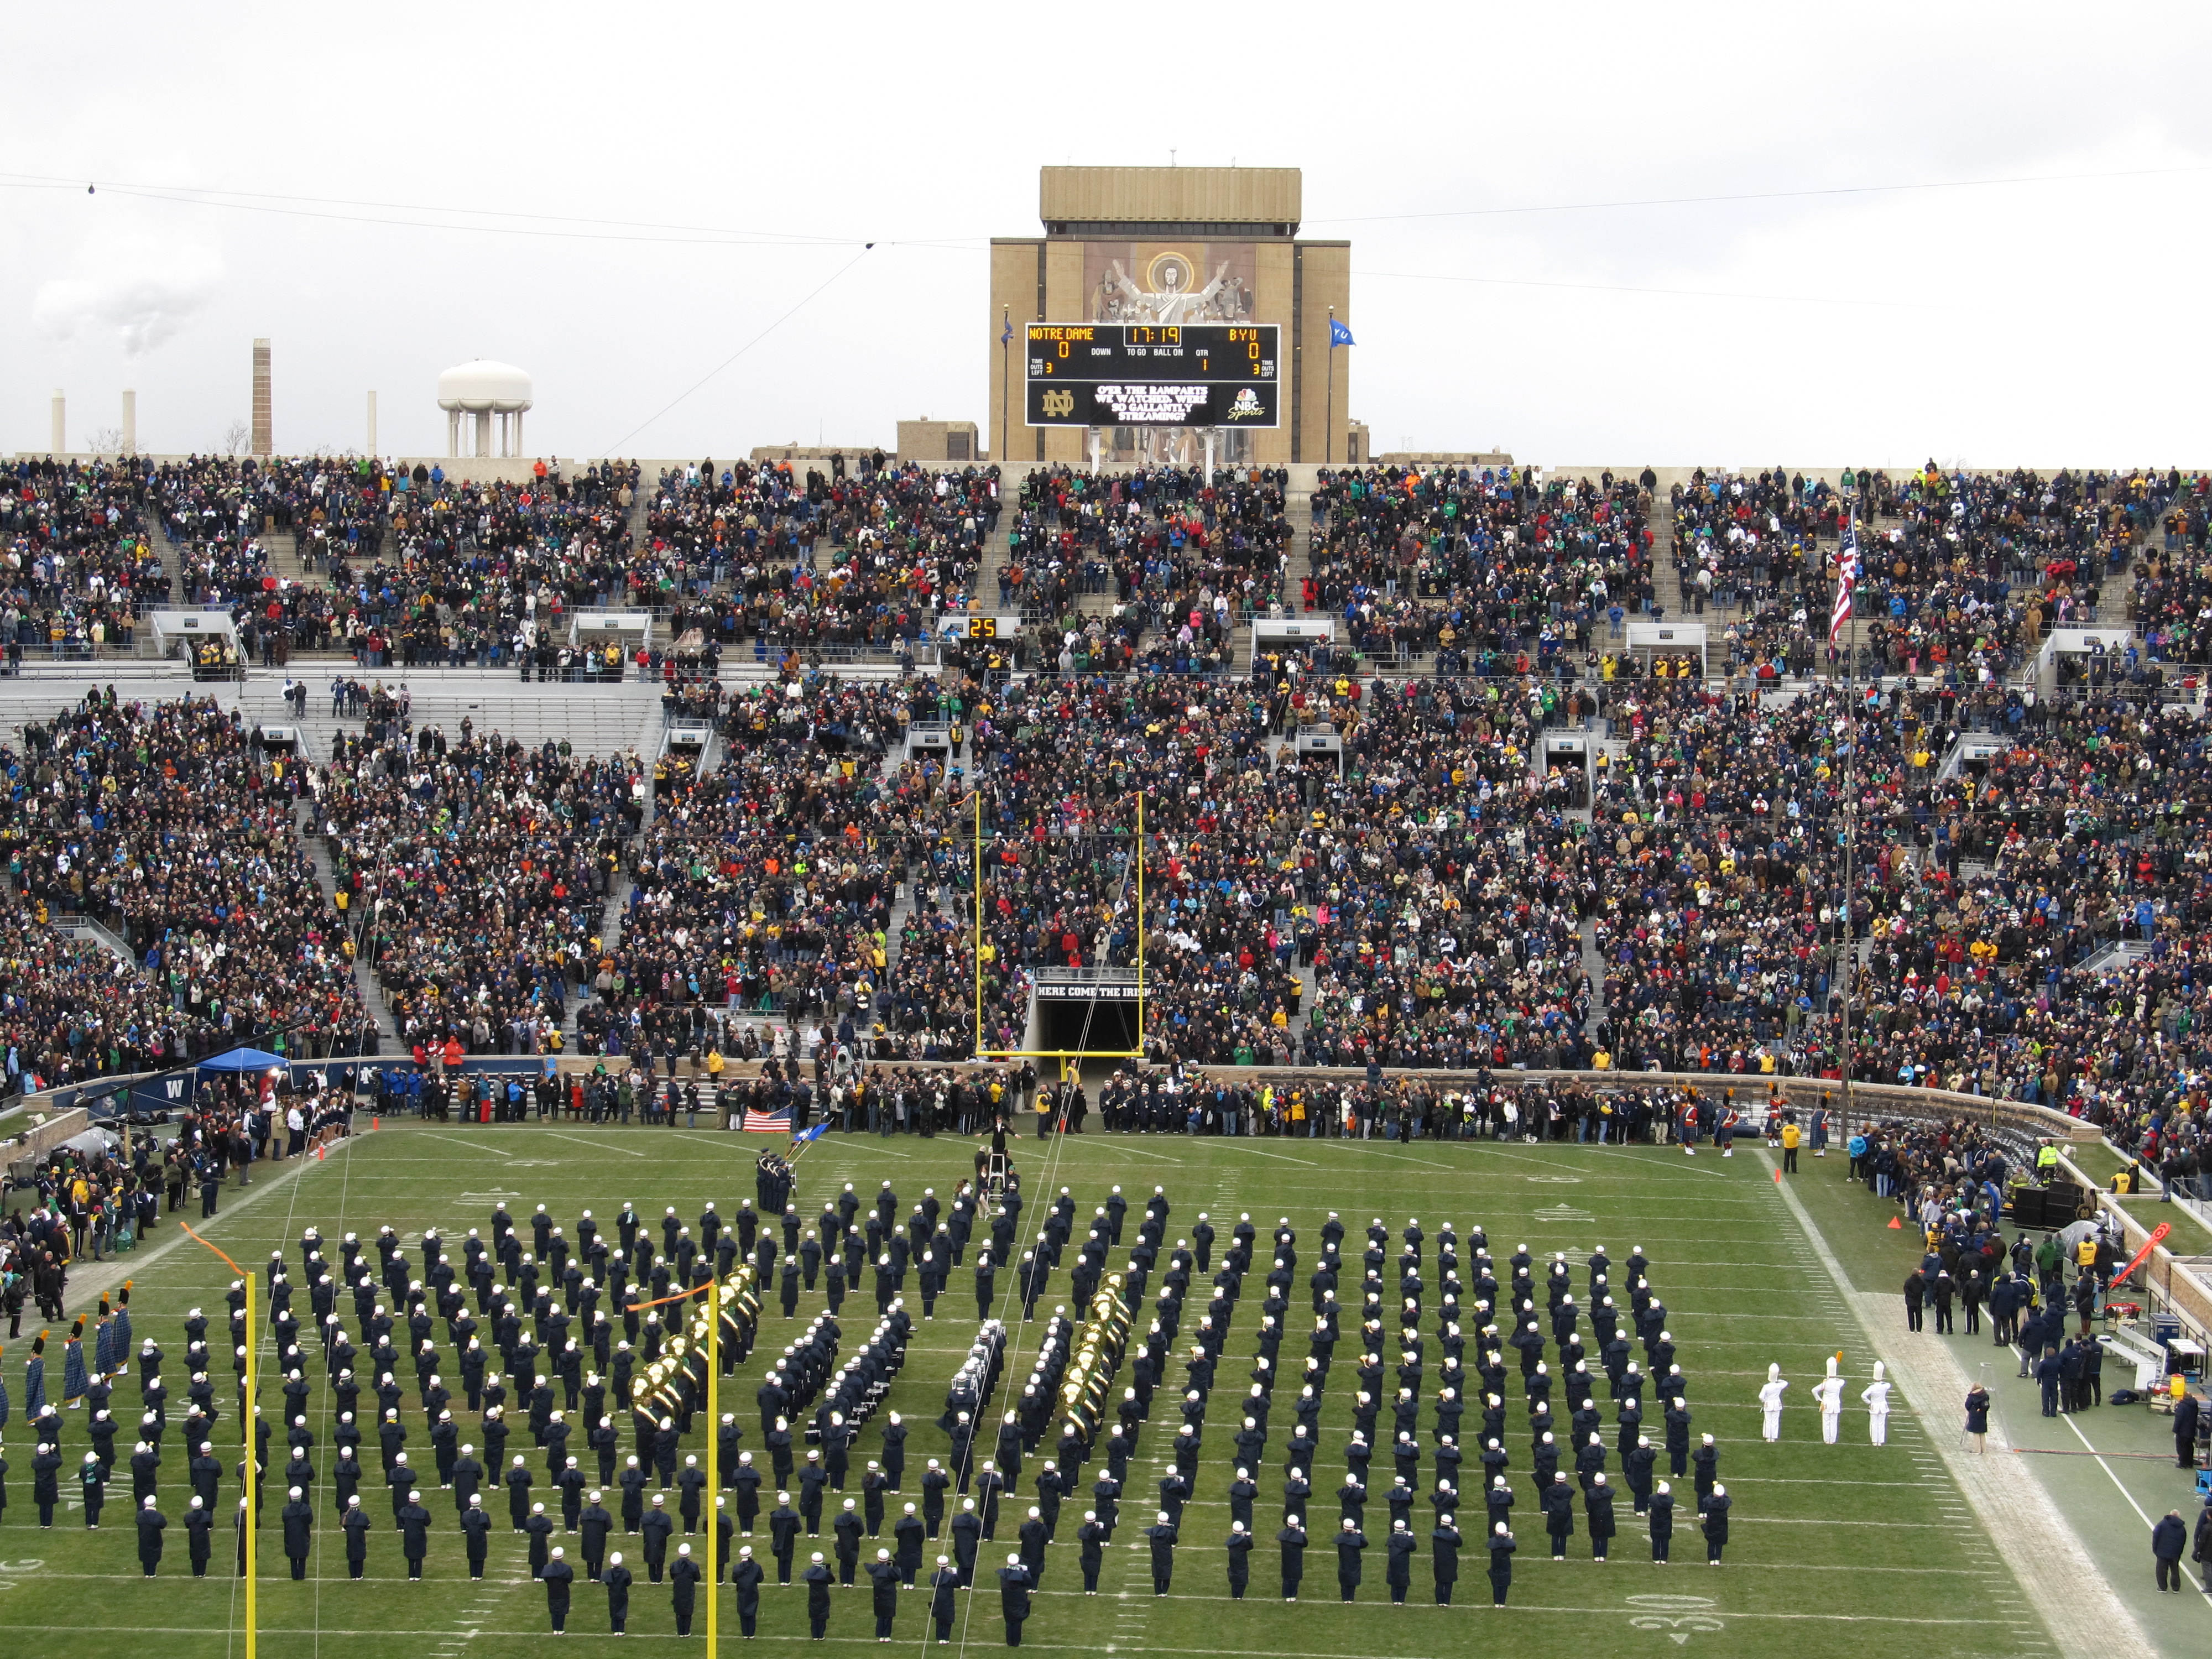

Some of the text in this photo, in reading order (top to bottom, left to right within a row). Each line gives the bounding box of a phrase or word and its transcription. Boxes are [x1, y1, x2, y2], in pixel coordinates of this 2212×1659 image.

[1029, 327, 1094, 340] NOTRE DAME
[1134, 327, 1178, 342] 17:19
[1229, 328, 1256, 341] BYU
[1058, 341, 1069, 358] 0
[1249, 342, 1259, 359] 0
[1046, 362, 1052, 373] 3
[1203, 359, 1207, 371] 1
[1253, 363, 1260, 374] 3
[1125, 386, 1146, 394] THE
[1149, 386, 1208, 395] RAMPARTS
[1095, 394, 1114, 403] WE
[1175, 395, 1207, 404] WERE
[1112, 403, 1192, 412] SO GALLANTLY
[1234, 401, 1259, 410] NBC
[1118, 412, 1186, 420] STREAMING?
[1227, 406, 1266, 421] Sports
[970, 619, 994, 637] 25
[1038, 987, 1066, 996] HERE
[1068, 987, 1097, 996] COME
[1099, 987, 1120, 997] THE
[166, 1079, 184, 1099] W
